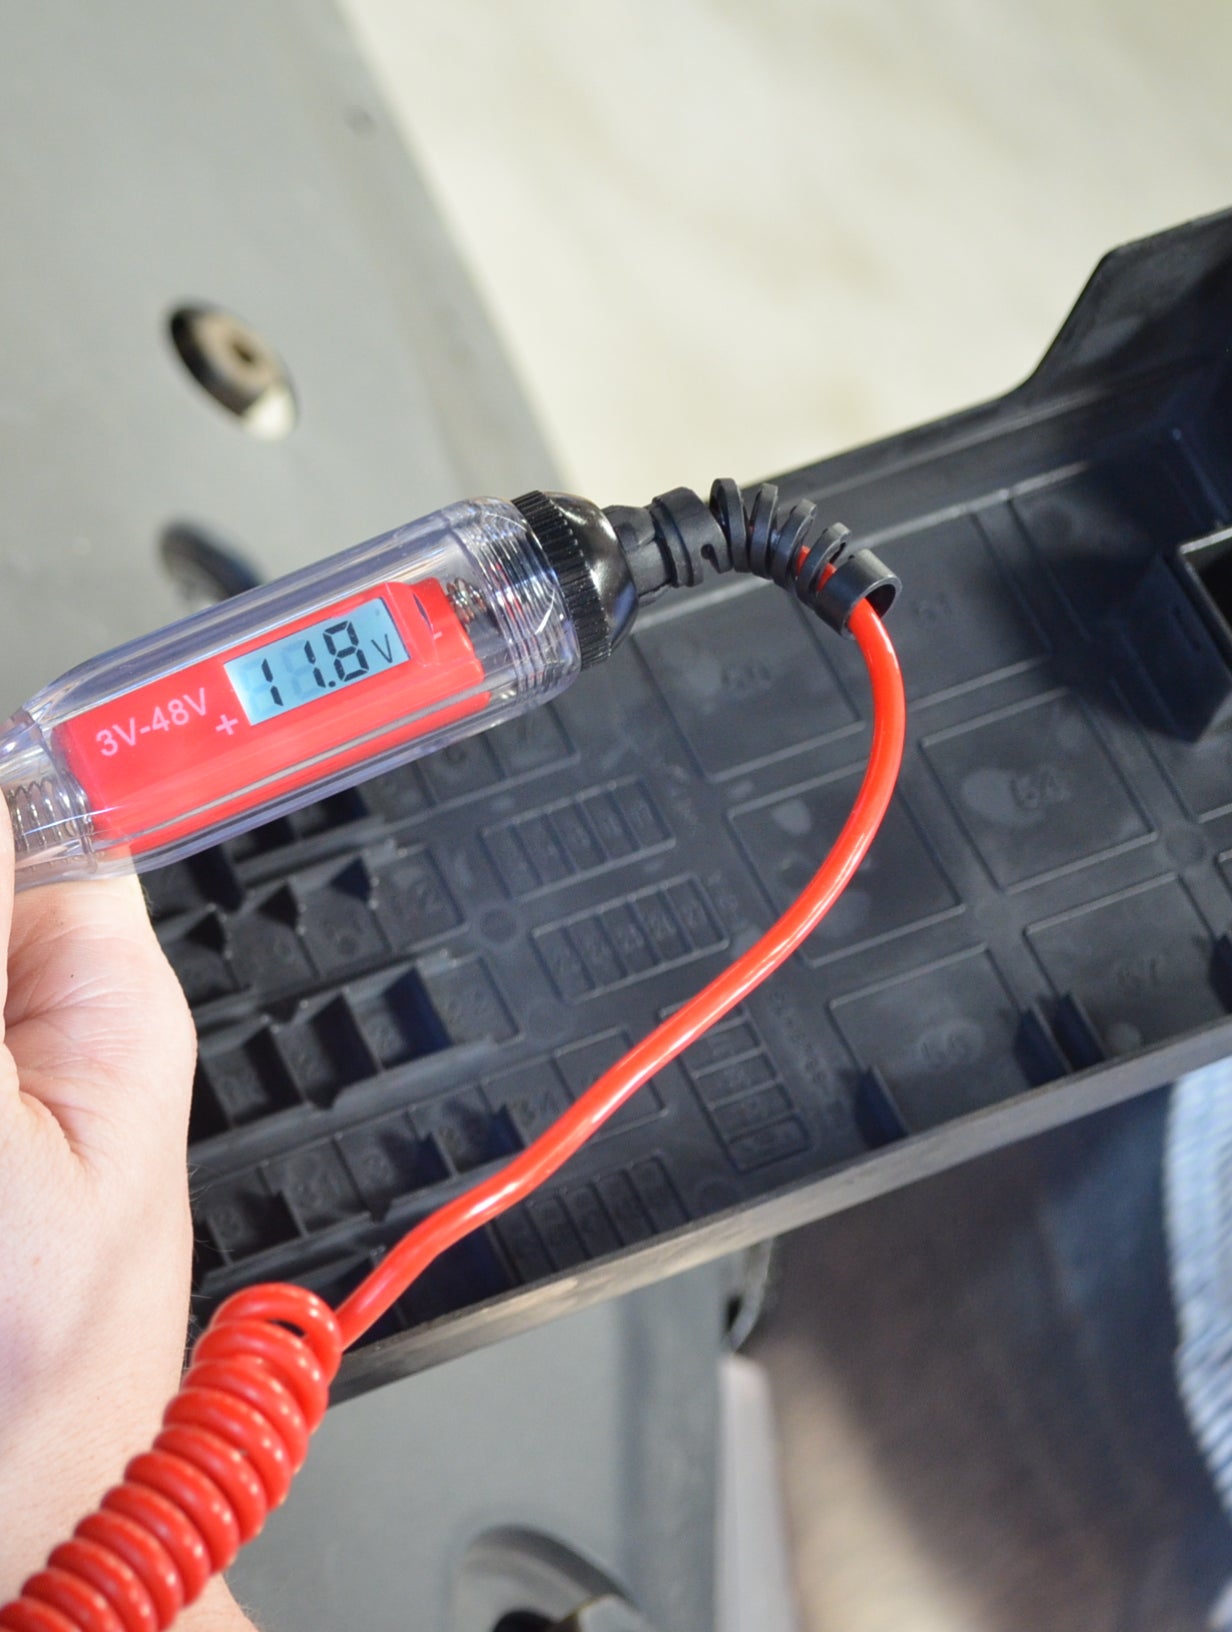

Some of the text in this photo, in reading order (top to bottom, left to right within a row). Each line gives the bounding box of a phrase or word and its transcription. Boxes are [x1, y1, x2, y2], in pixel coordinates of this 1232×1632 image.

[262, 620, 394, 708] 11.8 V
[95, 687, 209, 757] 3V-48V
